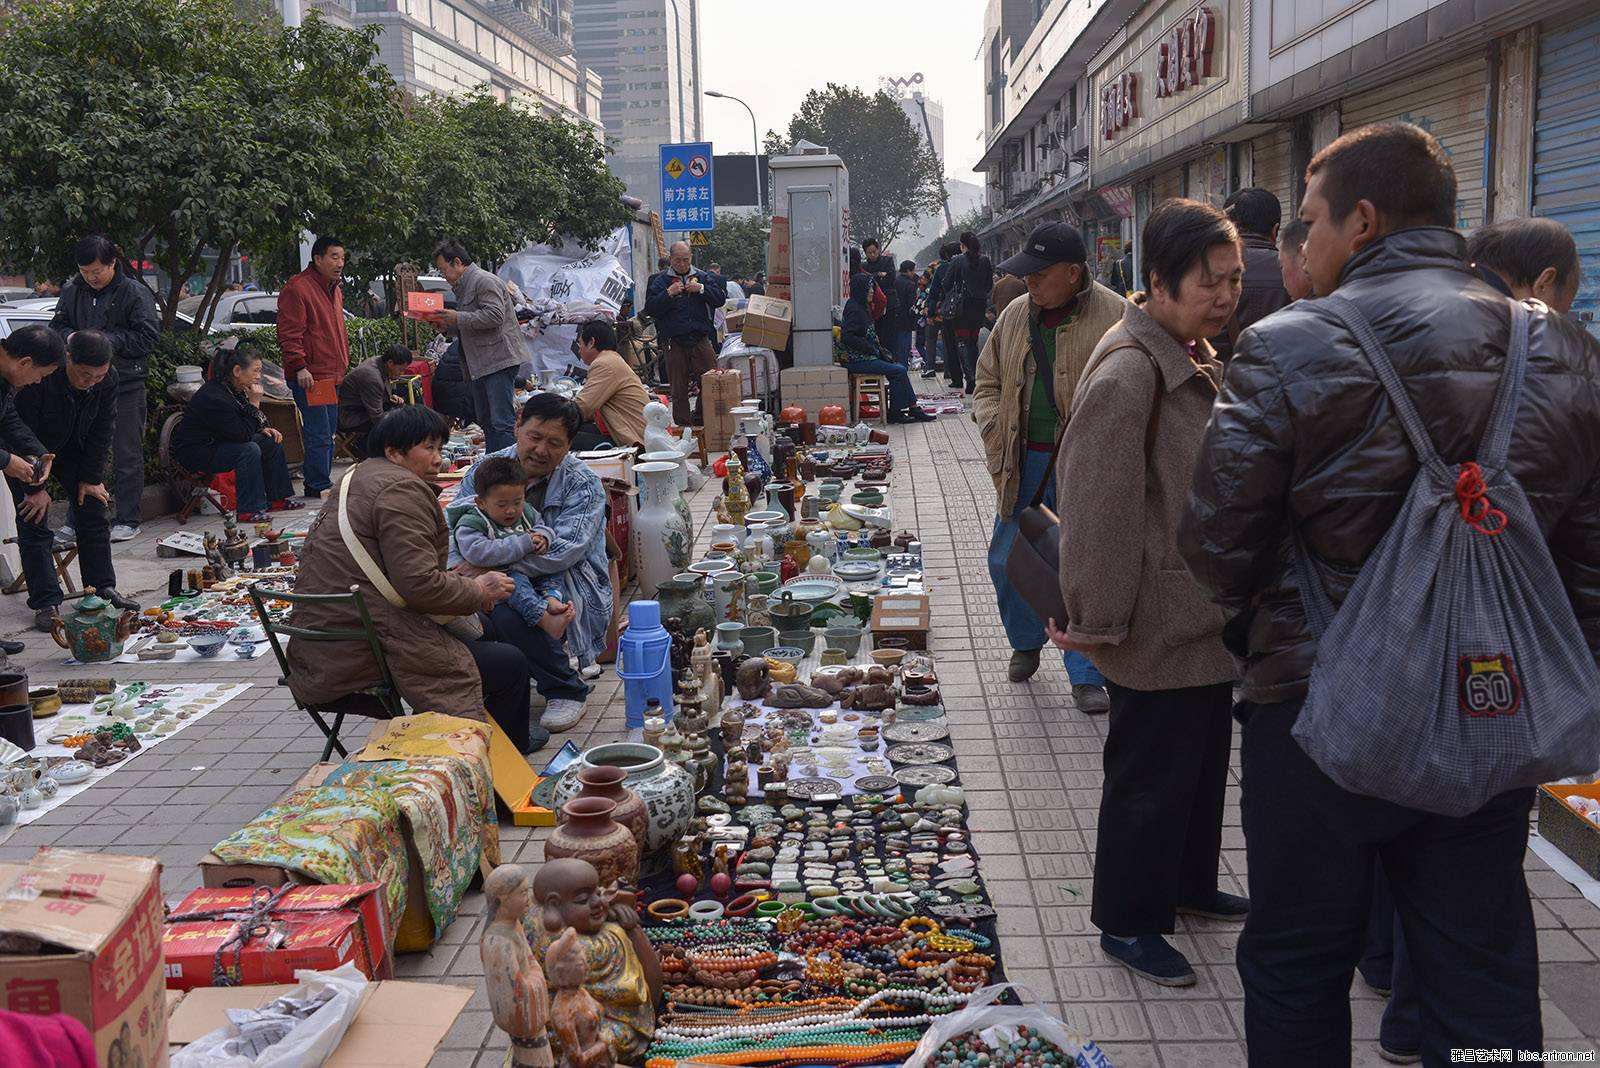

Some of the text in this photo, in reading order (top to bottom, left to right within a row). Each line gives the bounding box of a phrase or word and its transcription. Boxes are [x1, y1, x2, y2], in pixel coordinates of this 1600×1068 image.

[664, 186, 709, 201] 前方禁左
[665, 207, 710, 222] 车辆缓行
[1466, 672, 1513, 711] 60
